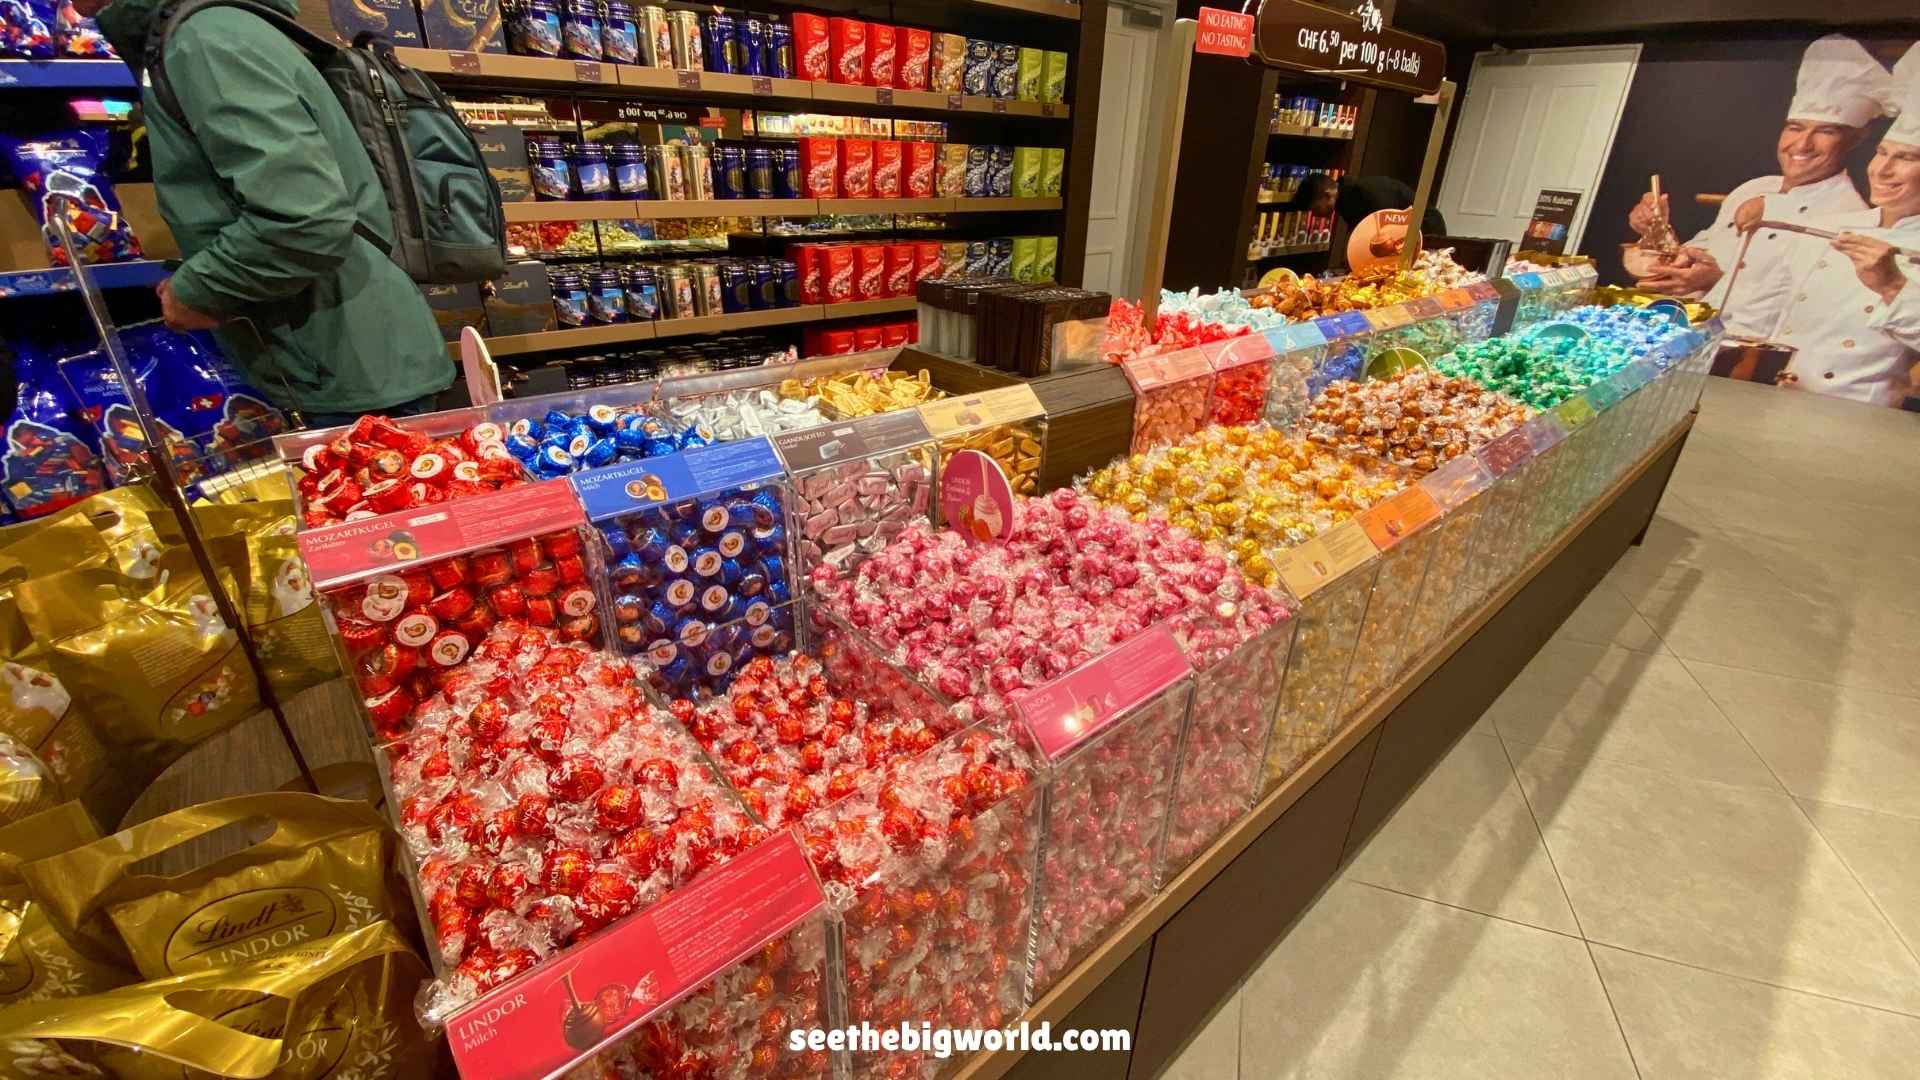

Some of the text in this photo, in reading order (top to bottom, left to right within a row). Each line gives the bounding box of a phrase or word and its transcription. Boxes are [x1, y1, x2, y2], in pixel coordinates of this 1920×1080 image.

[1206, 13, 1247, 30] NO EATING
[1201, 31, 1247, 49] NO TASTING
[1298, 28, 1320, 51] CHF
[1339, 40, 1358, 65] per
[1360, 42, 1378, 65] 100
[1377, 50, 1386, 73] g
[1400, 50, 1421, 78] balls)
[1384, 213, 1409, 223] NEW
[580, 466, 646, 486] MOZARTKUGEL
[305, 520, 396, 546] MOZARTKUGEL
[193, 901, 278, 947] Lindt
[459, 993, 528, 1041] LINDOR
[464, 1027, 498, 1054] Milch
